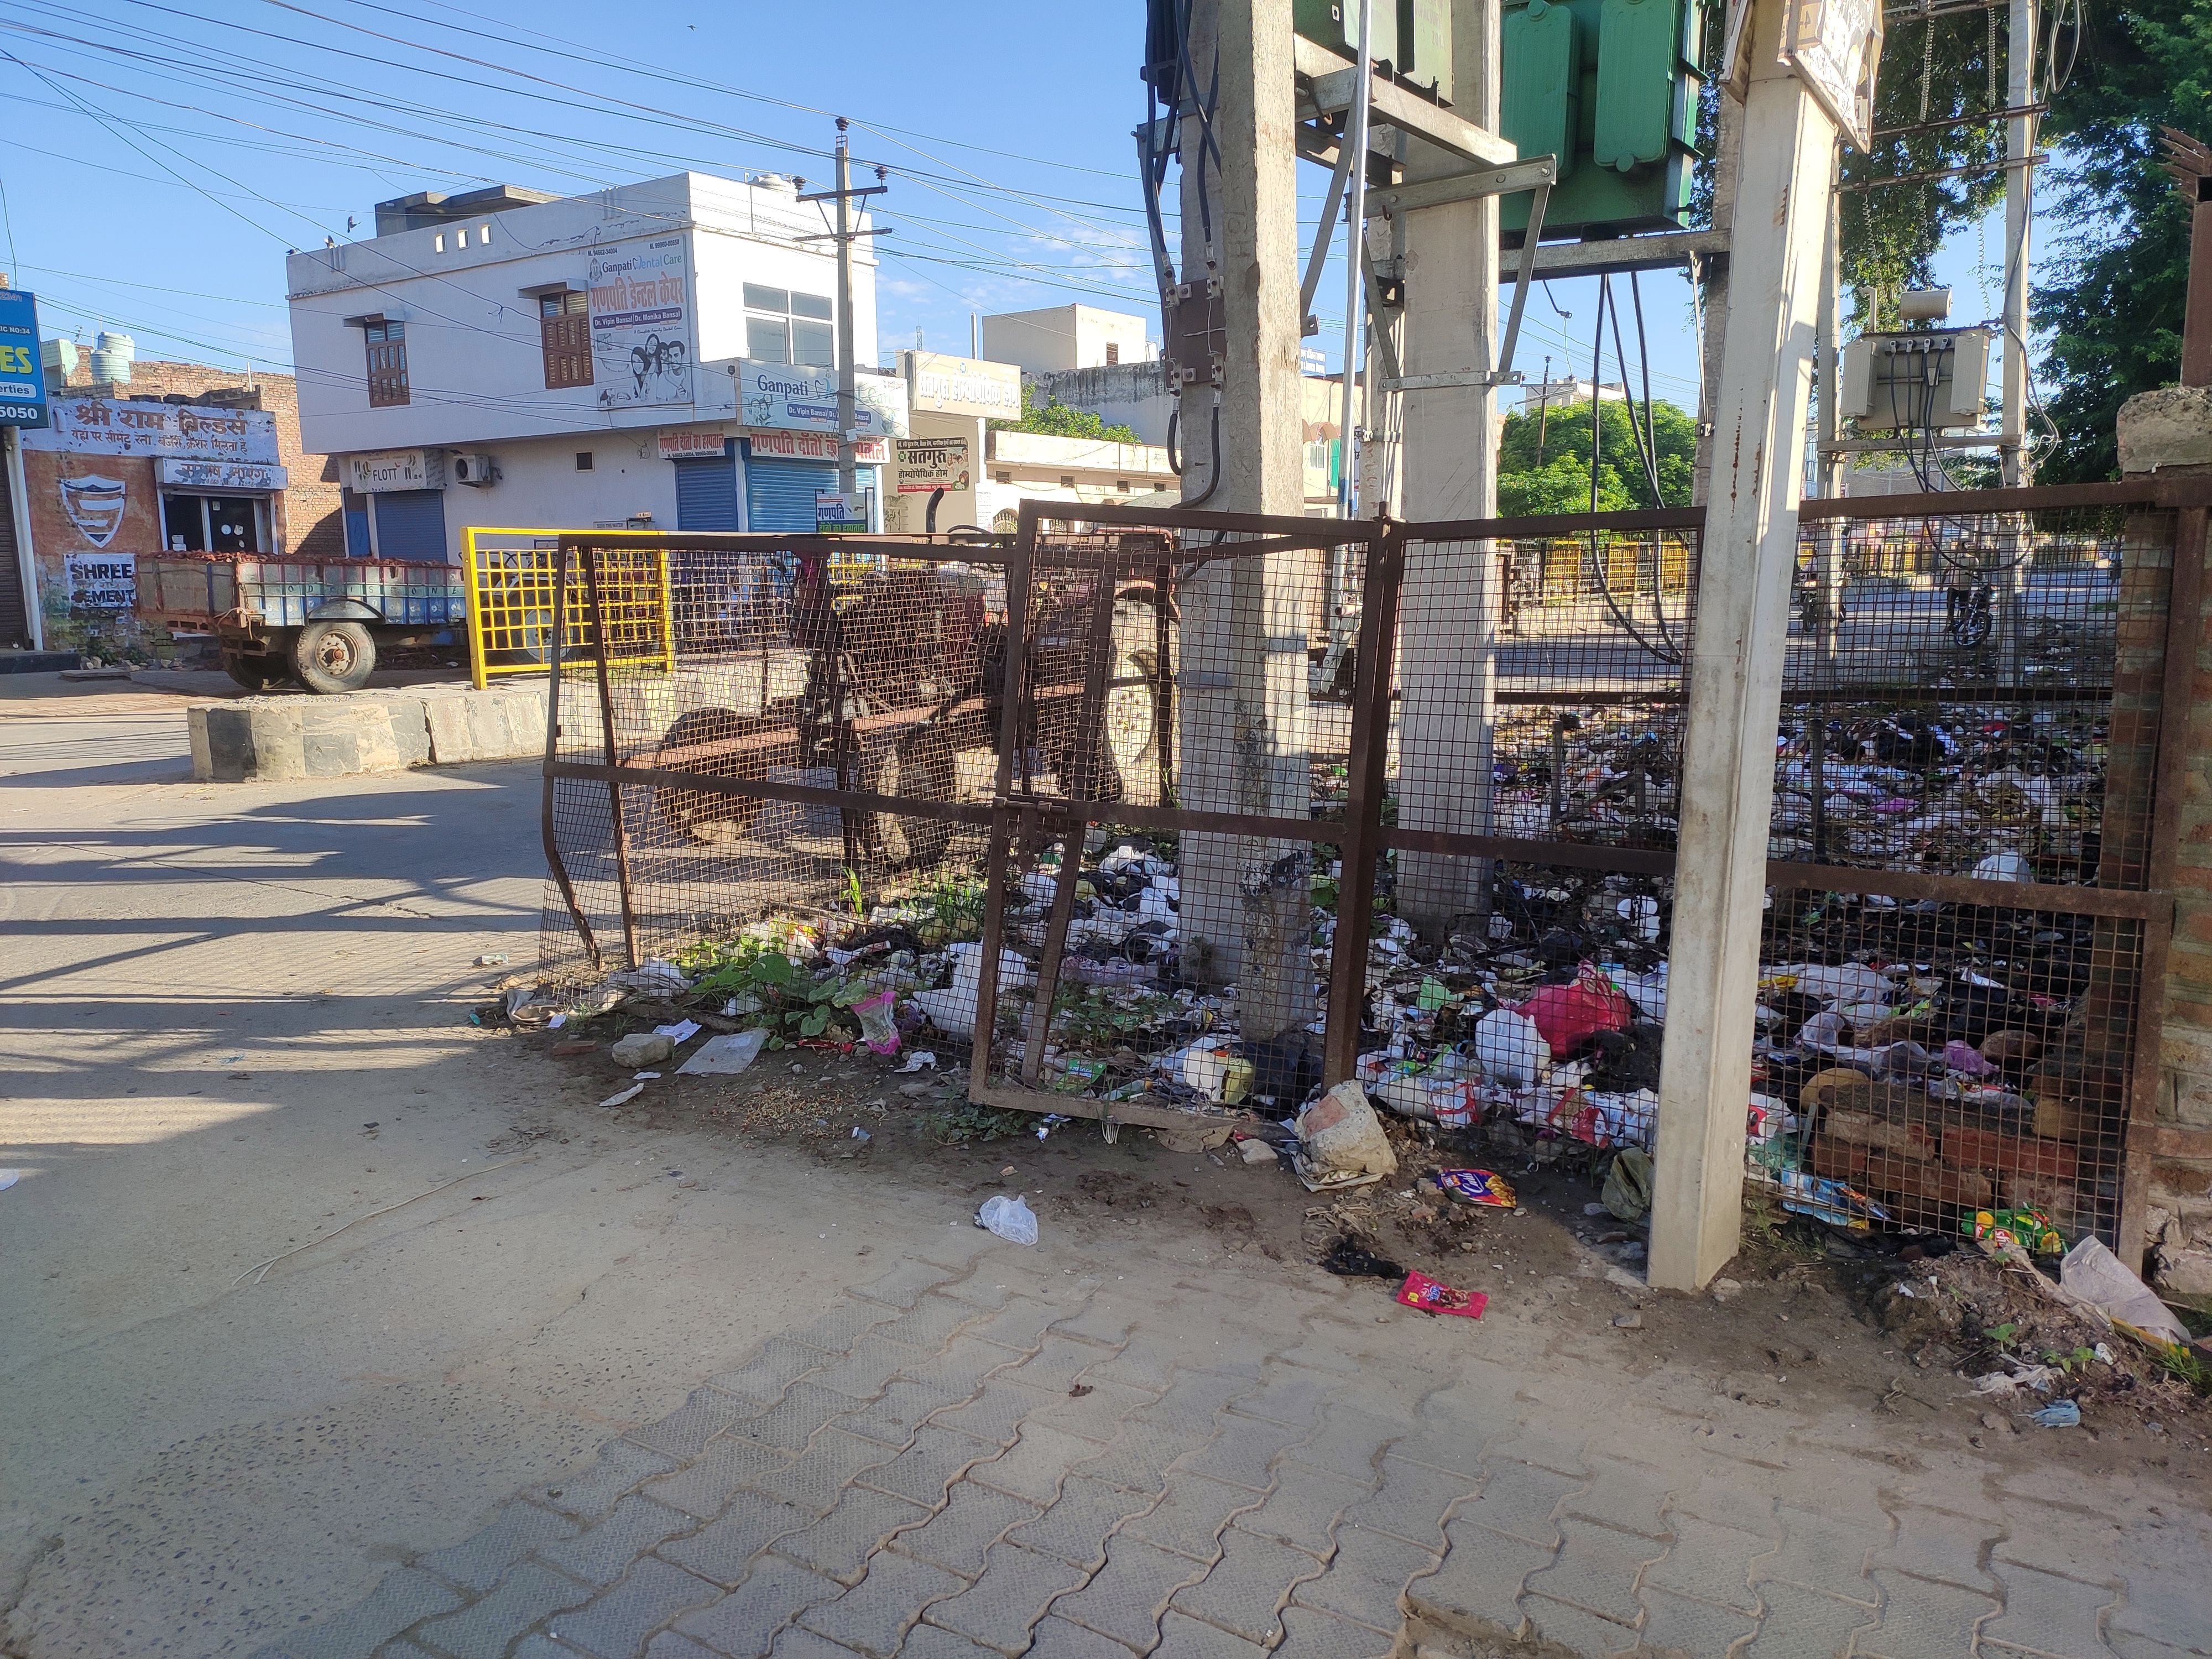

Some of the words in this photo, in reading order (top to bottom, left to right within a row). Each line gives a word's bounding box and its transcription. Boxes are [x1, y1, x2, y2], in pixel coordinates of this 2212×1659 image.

[602, 259, 632, 275] Ganpati
[664, 254, 682, 265] Care
[591, 276, 628, 312] गणपति
[628, 275, 658, 309] डेन्टल
[659, 271, 684, 305] केयर
[602, 318, 615, 326] Vipin
[615, 316, 633, 324] Bansal
[662, 310, 680, 319] Bansal
[758, 374, 808, 400] Ganpati
[75, 401, 113, 425] श्री
[120, 409, 165, 430] राम
[178, 408, 248, 435] बिल्डर्स
[797, 408, 810, 417] Vipin
[810, 409, 827, 418] Bansal
[90, 431, 103, 442] पर
[659, 433, 679, 452] गणपति
[693, 435, 701, 450] का
[702, 434, 724, 449] हस्पताल
[750, 430, 795, 454] गणपति
[373, 468, 397, 482] FLOTT
[935, 467, 948, 477] होम
[818, 503, 844, 520] गणपति
[70, 564, 133, 579] SHREE
